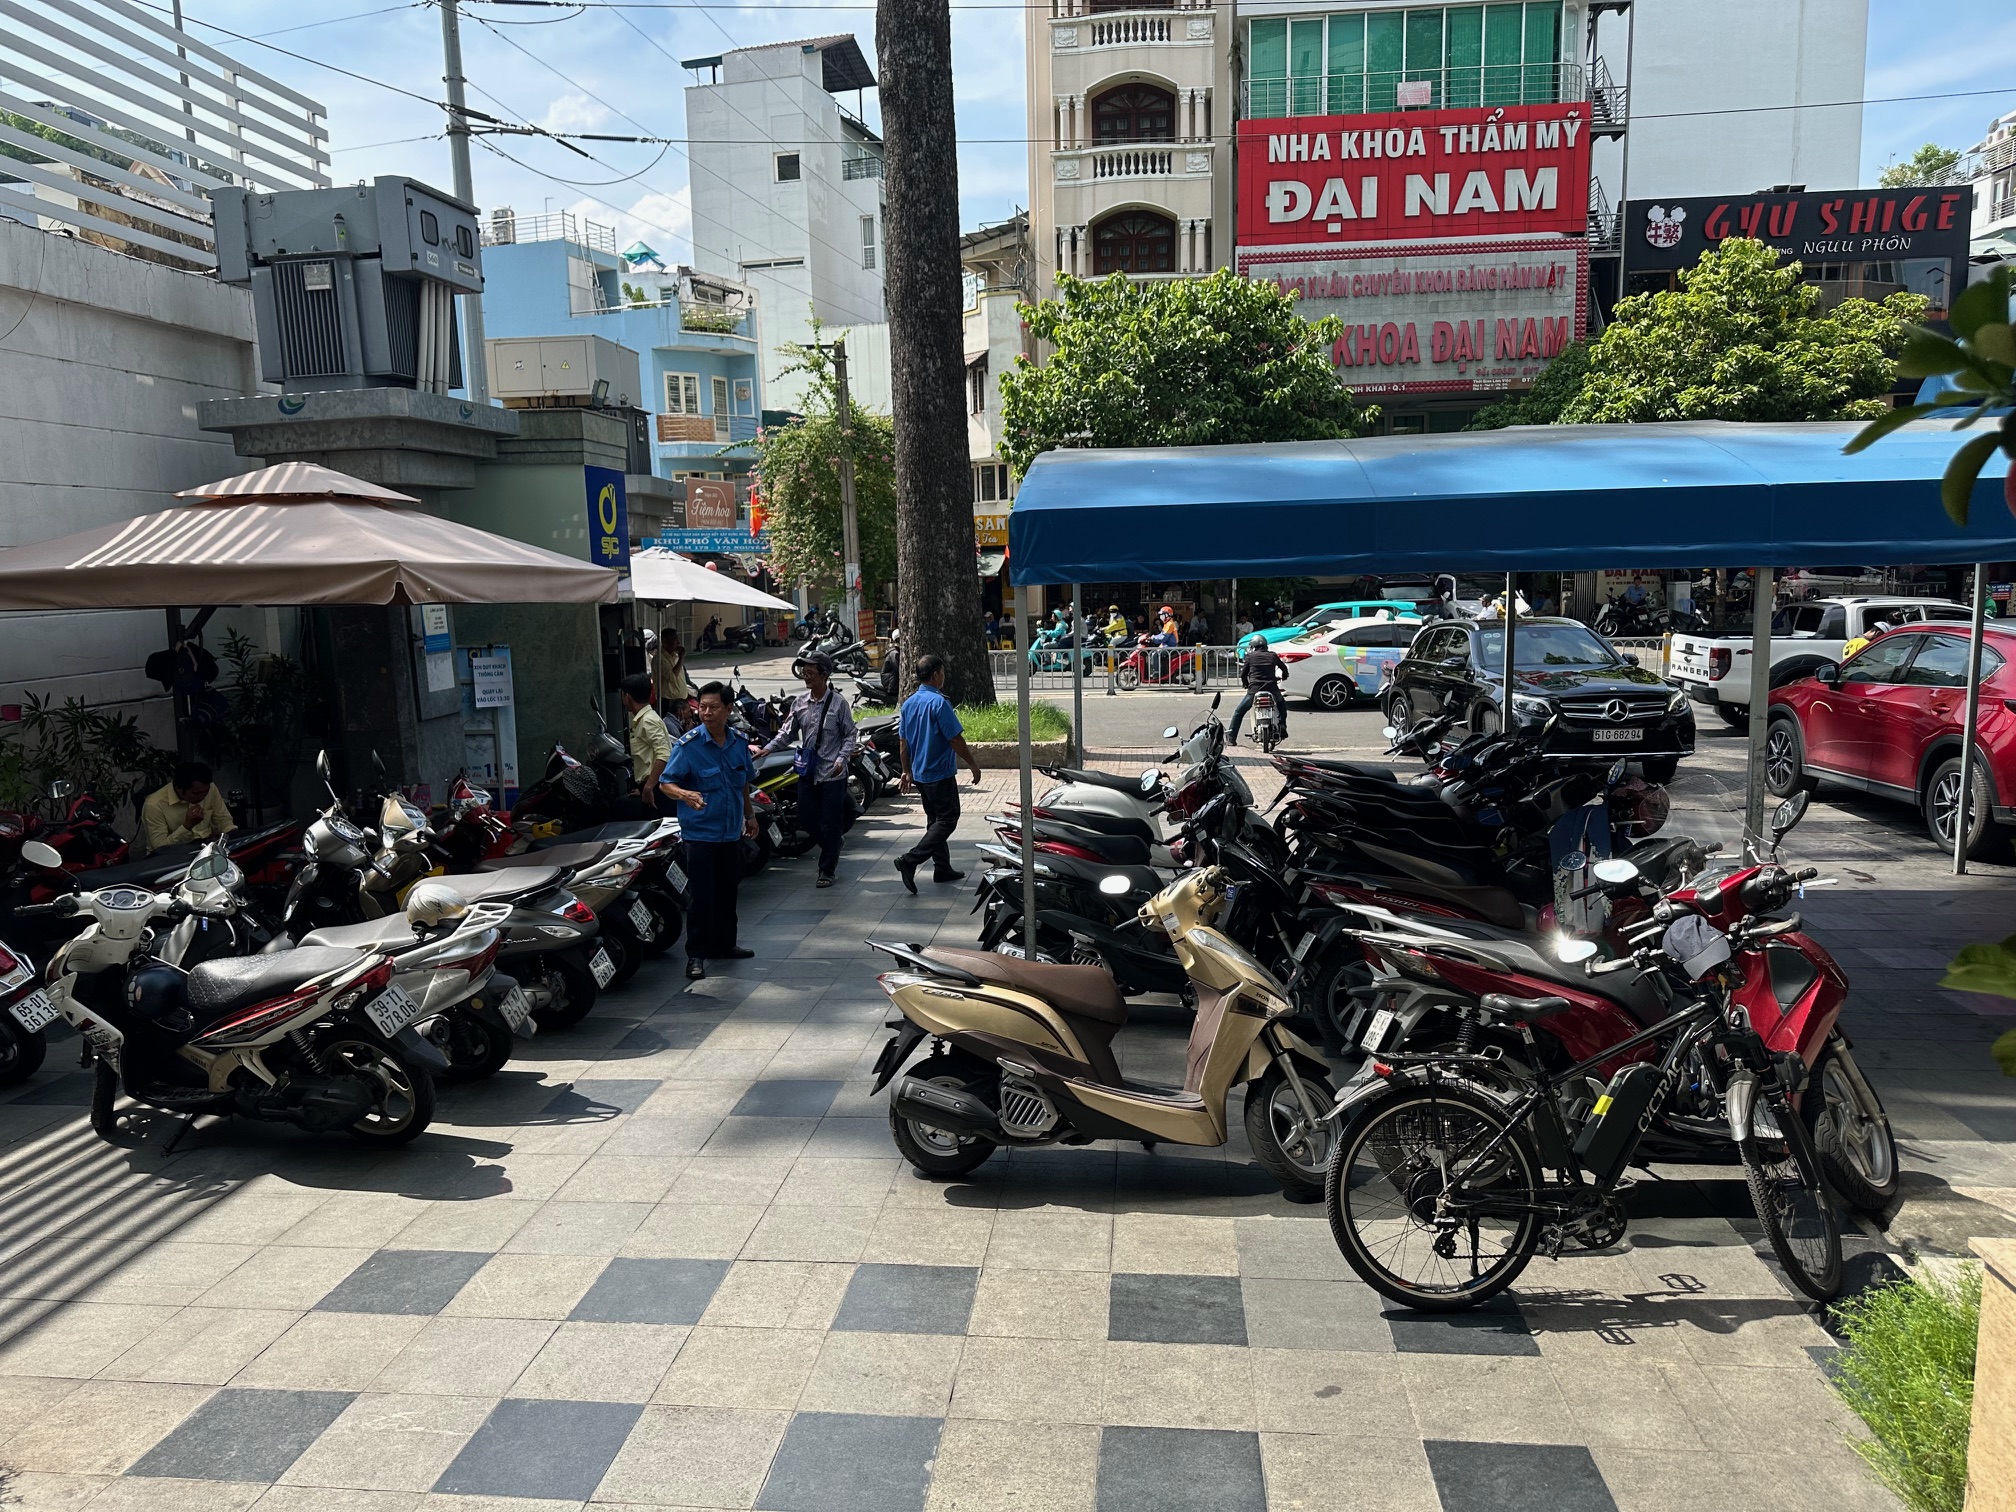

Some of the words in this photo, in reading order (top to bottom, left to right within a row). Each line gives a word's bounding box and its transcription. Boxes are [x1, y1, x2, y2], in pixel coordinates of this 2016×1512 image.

[1268, 133, 1331, 163] NHA
[1341, 127, 1427, 160] KHOA
[1440, 107, 1527, 154] THẨM
[1536, 110, 1583, 149] MỸ
[1265, 175, 1378, 234] ĐẠI
[1405, 166, 1558, 218] NAM
[1704, 201, 1799, 241] GYU
[1821, 194, 1962, 235] SHIGE
[1308, 271, 1349, 299] KHÁM
[1414, 266, 1452, 294] KHOA
[1456, 263, 1497, 292] RĂNG
[1332, 321, 1421, 367] KHOA
[1432, 318, 1485, 374] ĐẠI
[1496, 315, 1569, 360] NAM
[601, 536, 620, 560] SJC
[684, 535, 710, 545] PHỐ
[714, 536, 739, 545] VĂN
[982, 533, 998, 543] Tea
[1671, 663, 1709, 677] RANGER
[1373, 893, 1420, 908] VISION
[373, 990, 403, 1018] 59-T1
[380, 1000, 418, 1035] 078.06
